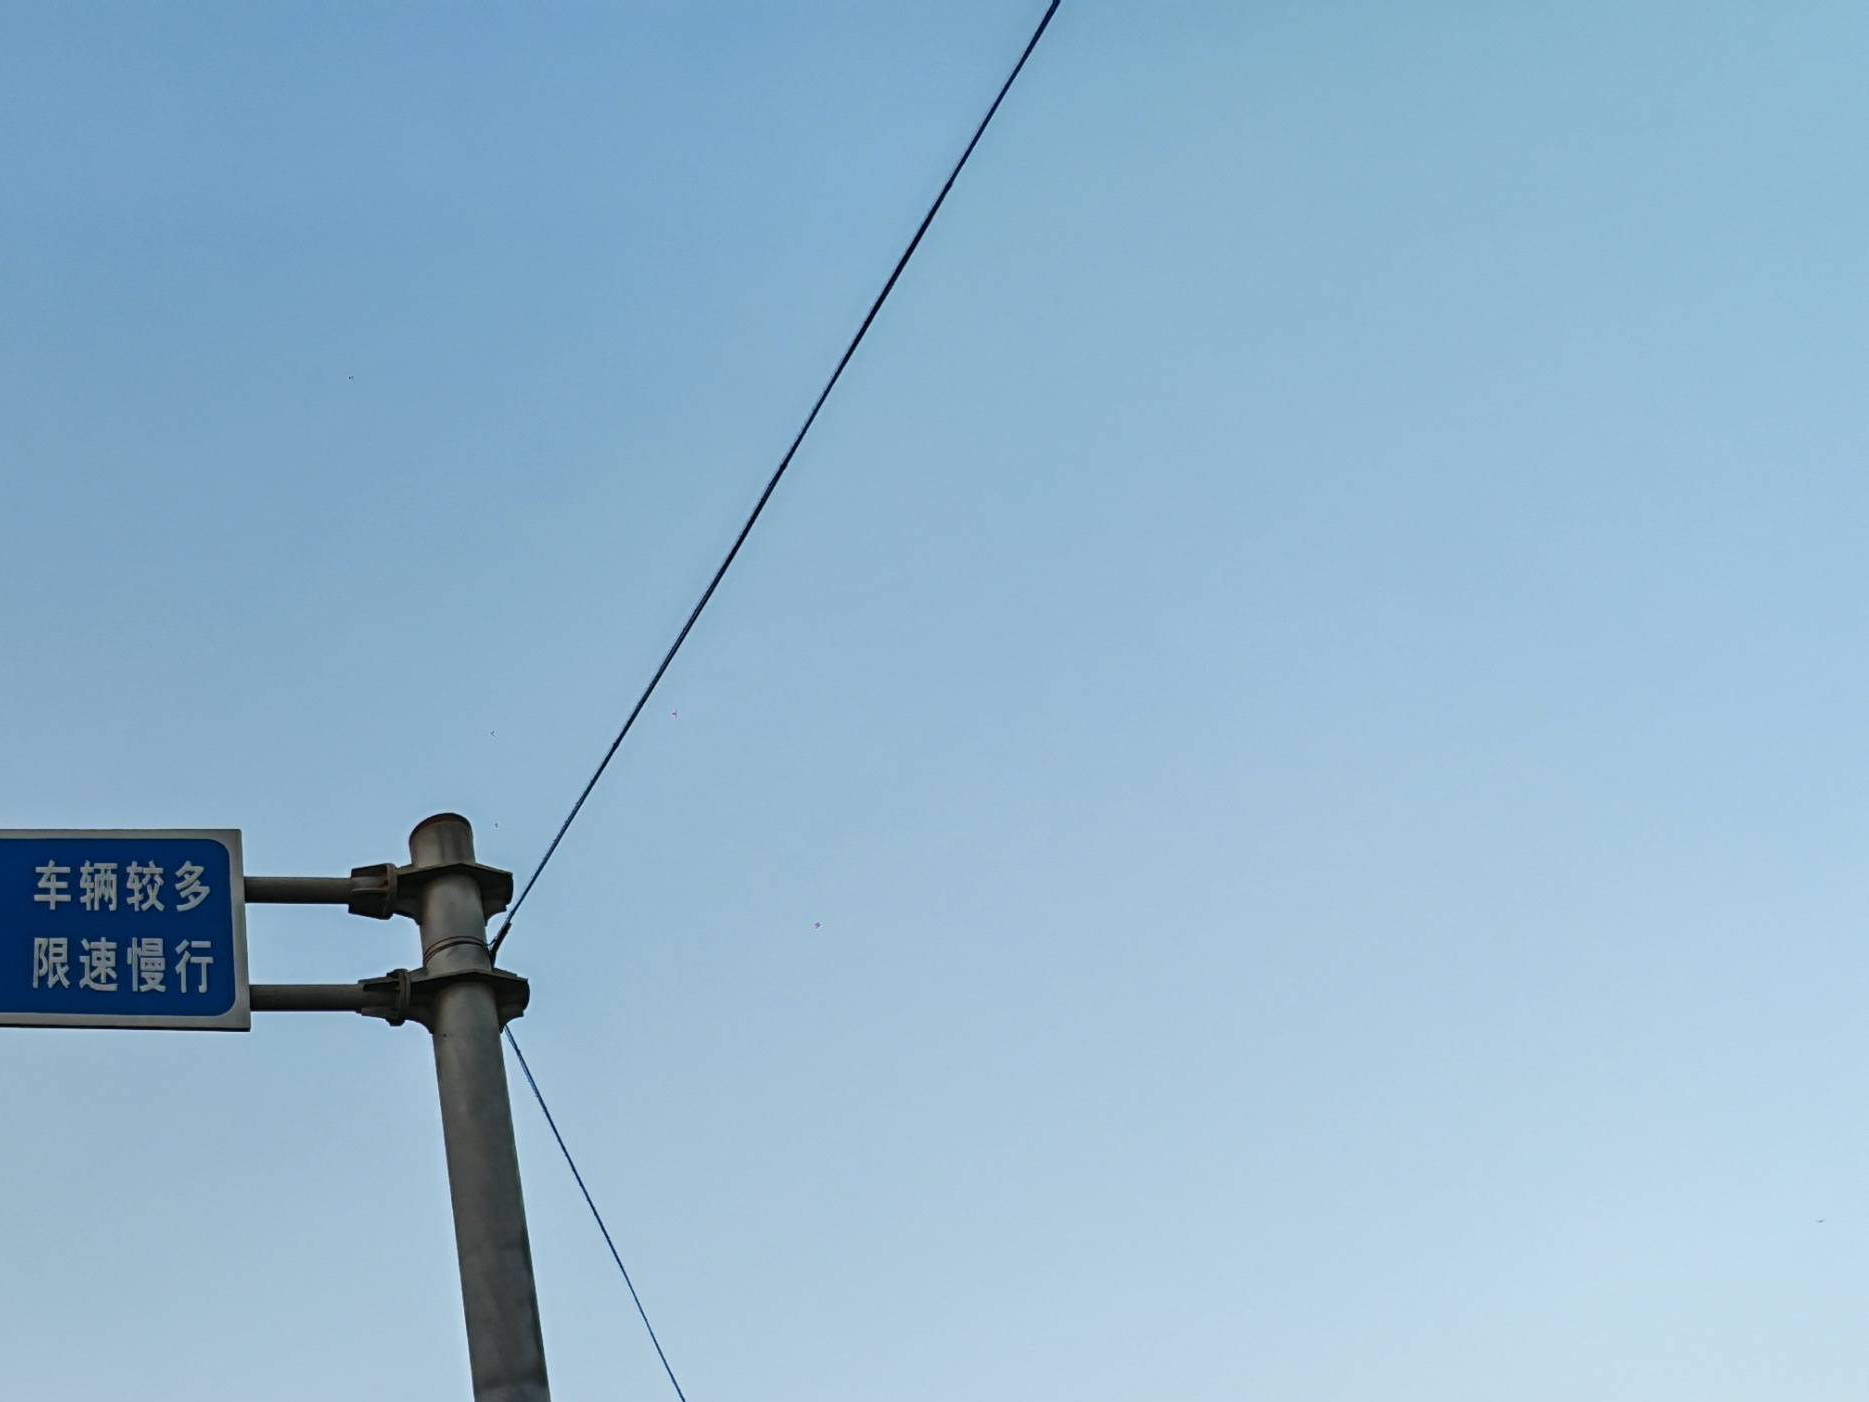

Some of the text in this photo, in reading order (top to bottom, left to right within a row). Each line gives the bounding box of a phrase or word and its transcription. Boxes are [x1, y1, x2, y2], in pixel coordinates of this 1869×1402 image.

[33, 860, 211, 912] 车辆较多
[32, 937, 215, 993] 限速慢行
